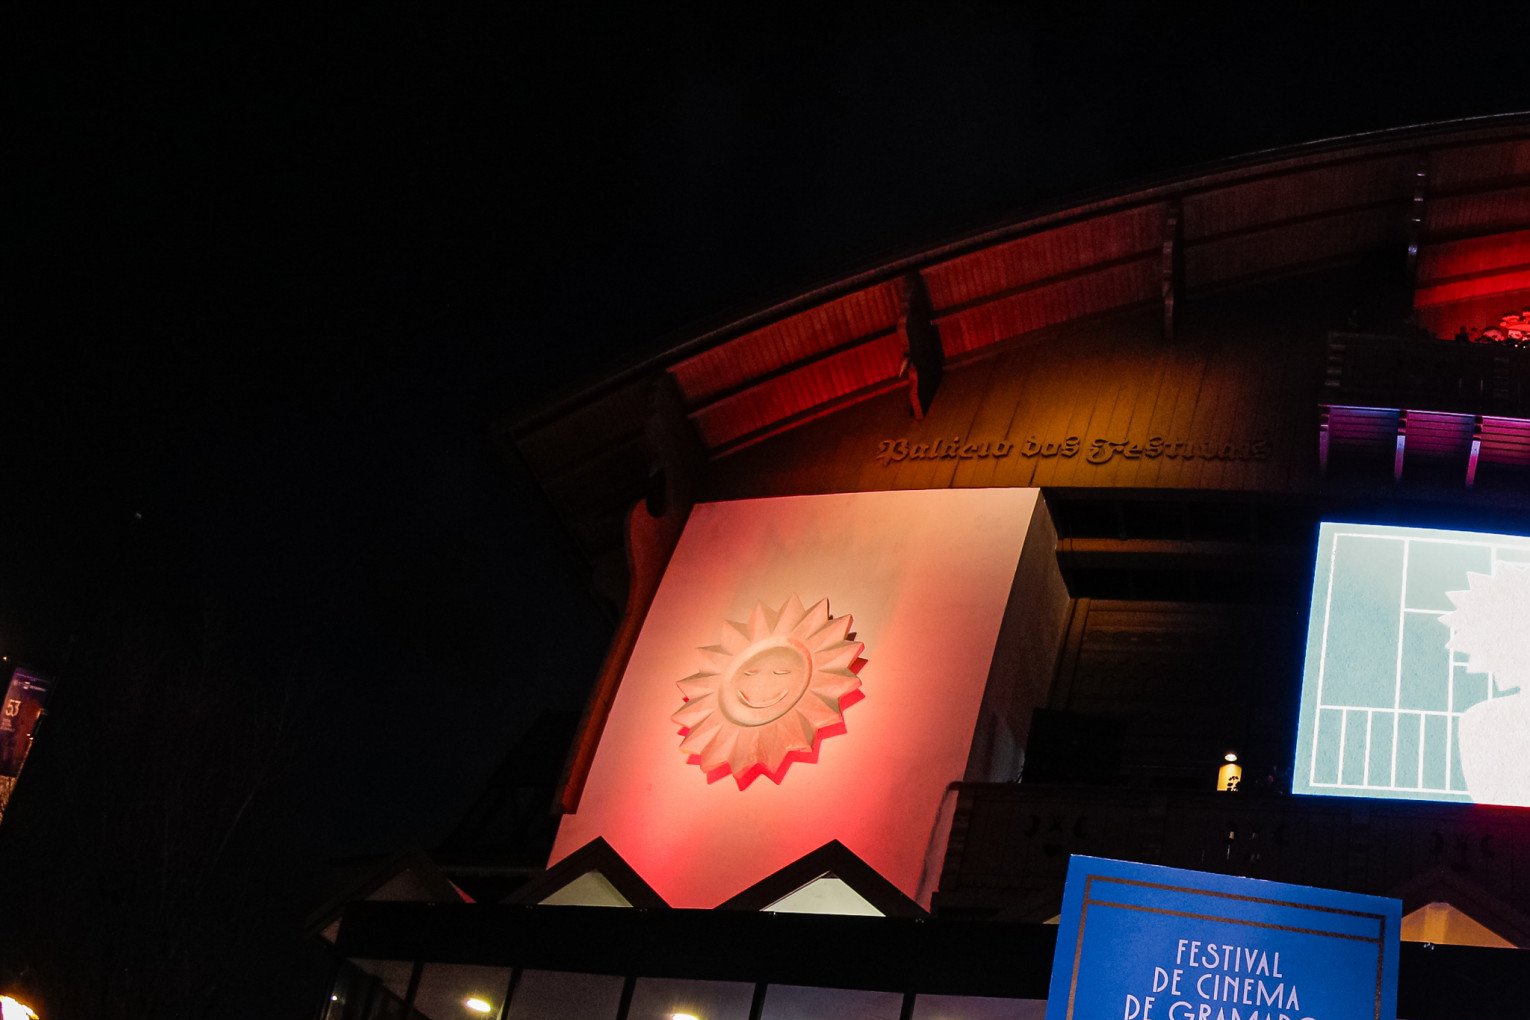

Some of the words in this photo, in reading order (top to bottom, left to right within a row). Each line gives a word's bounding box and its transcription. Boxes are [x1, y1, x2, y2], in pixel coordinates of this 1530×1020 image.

[1176, 939, 1283, 978] FESTIVAL
[1152, 966, 1184, 996] DE
[1196, 973, 1300, 1011] CINEMA
